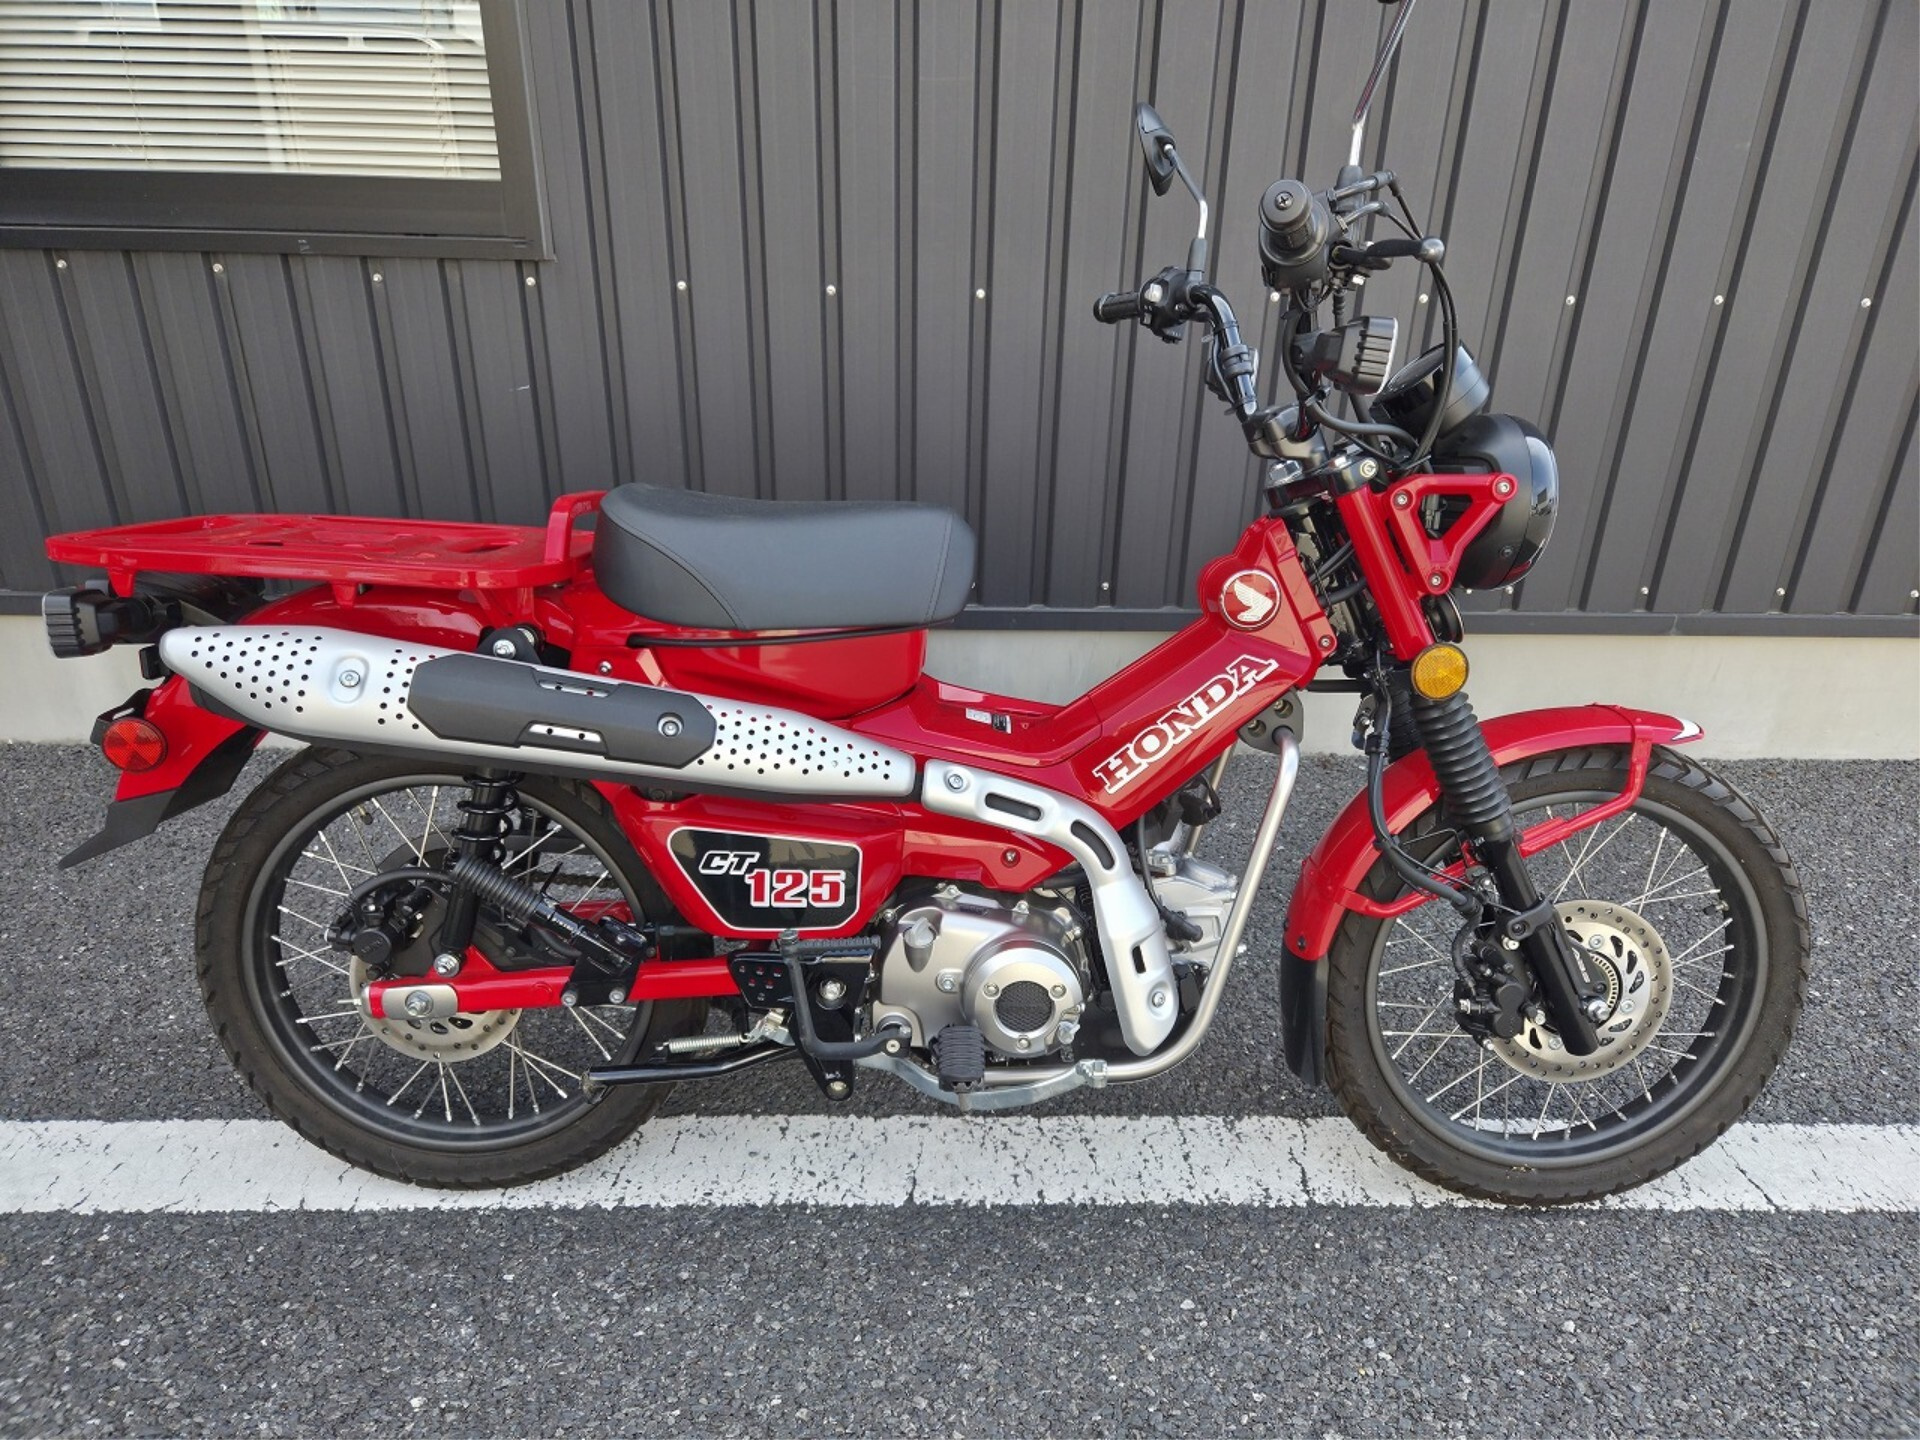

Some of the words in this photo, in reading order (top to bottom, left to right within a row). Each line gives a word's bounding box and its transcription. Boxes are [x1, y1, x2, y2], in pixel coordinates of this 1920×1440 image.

[1092, 654, 1279, 794] HONDA
[699, 850, 760, 875] CT
[745, 868, 846, 908] 125
